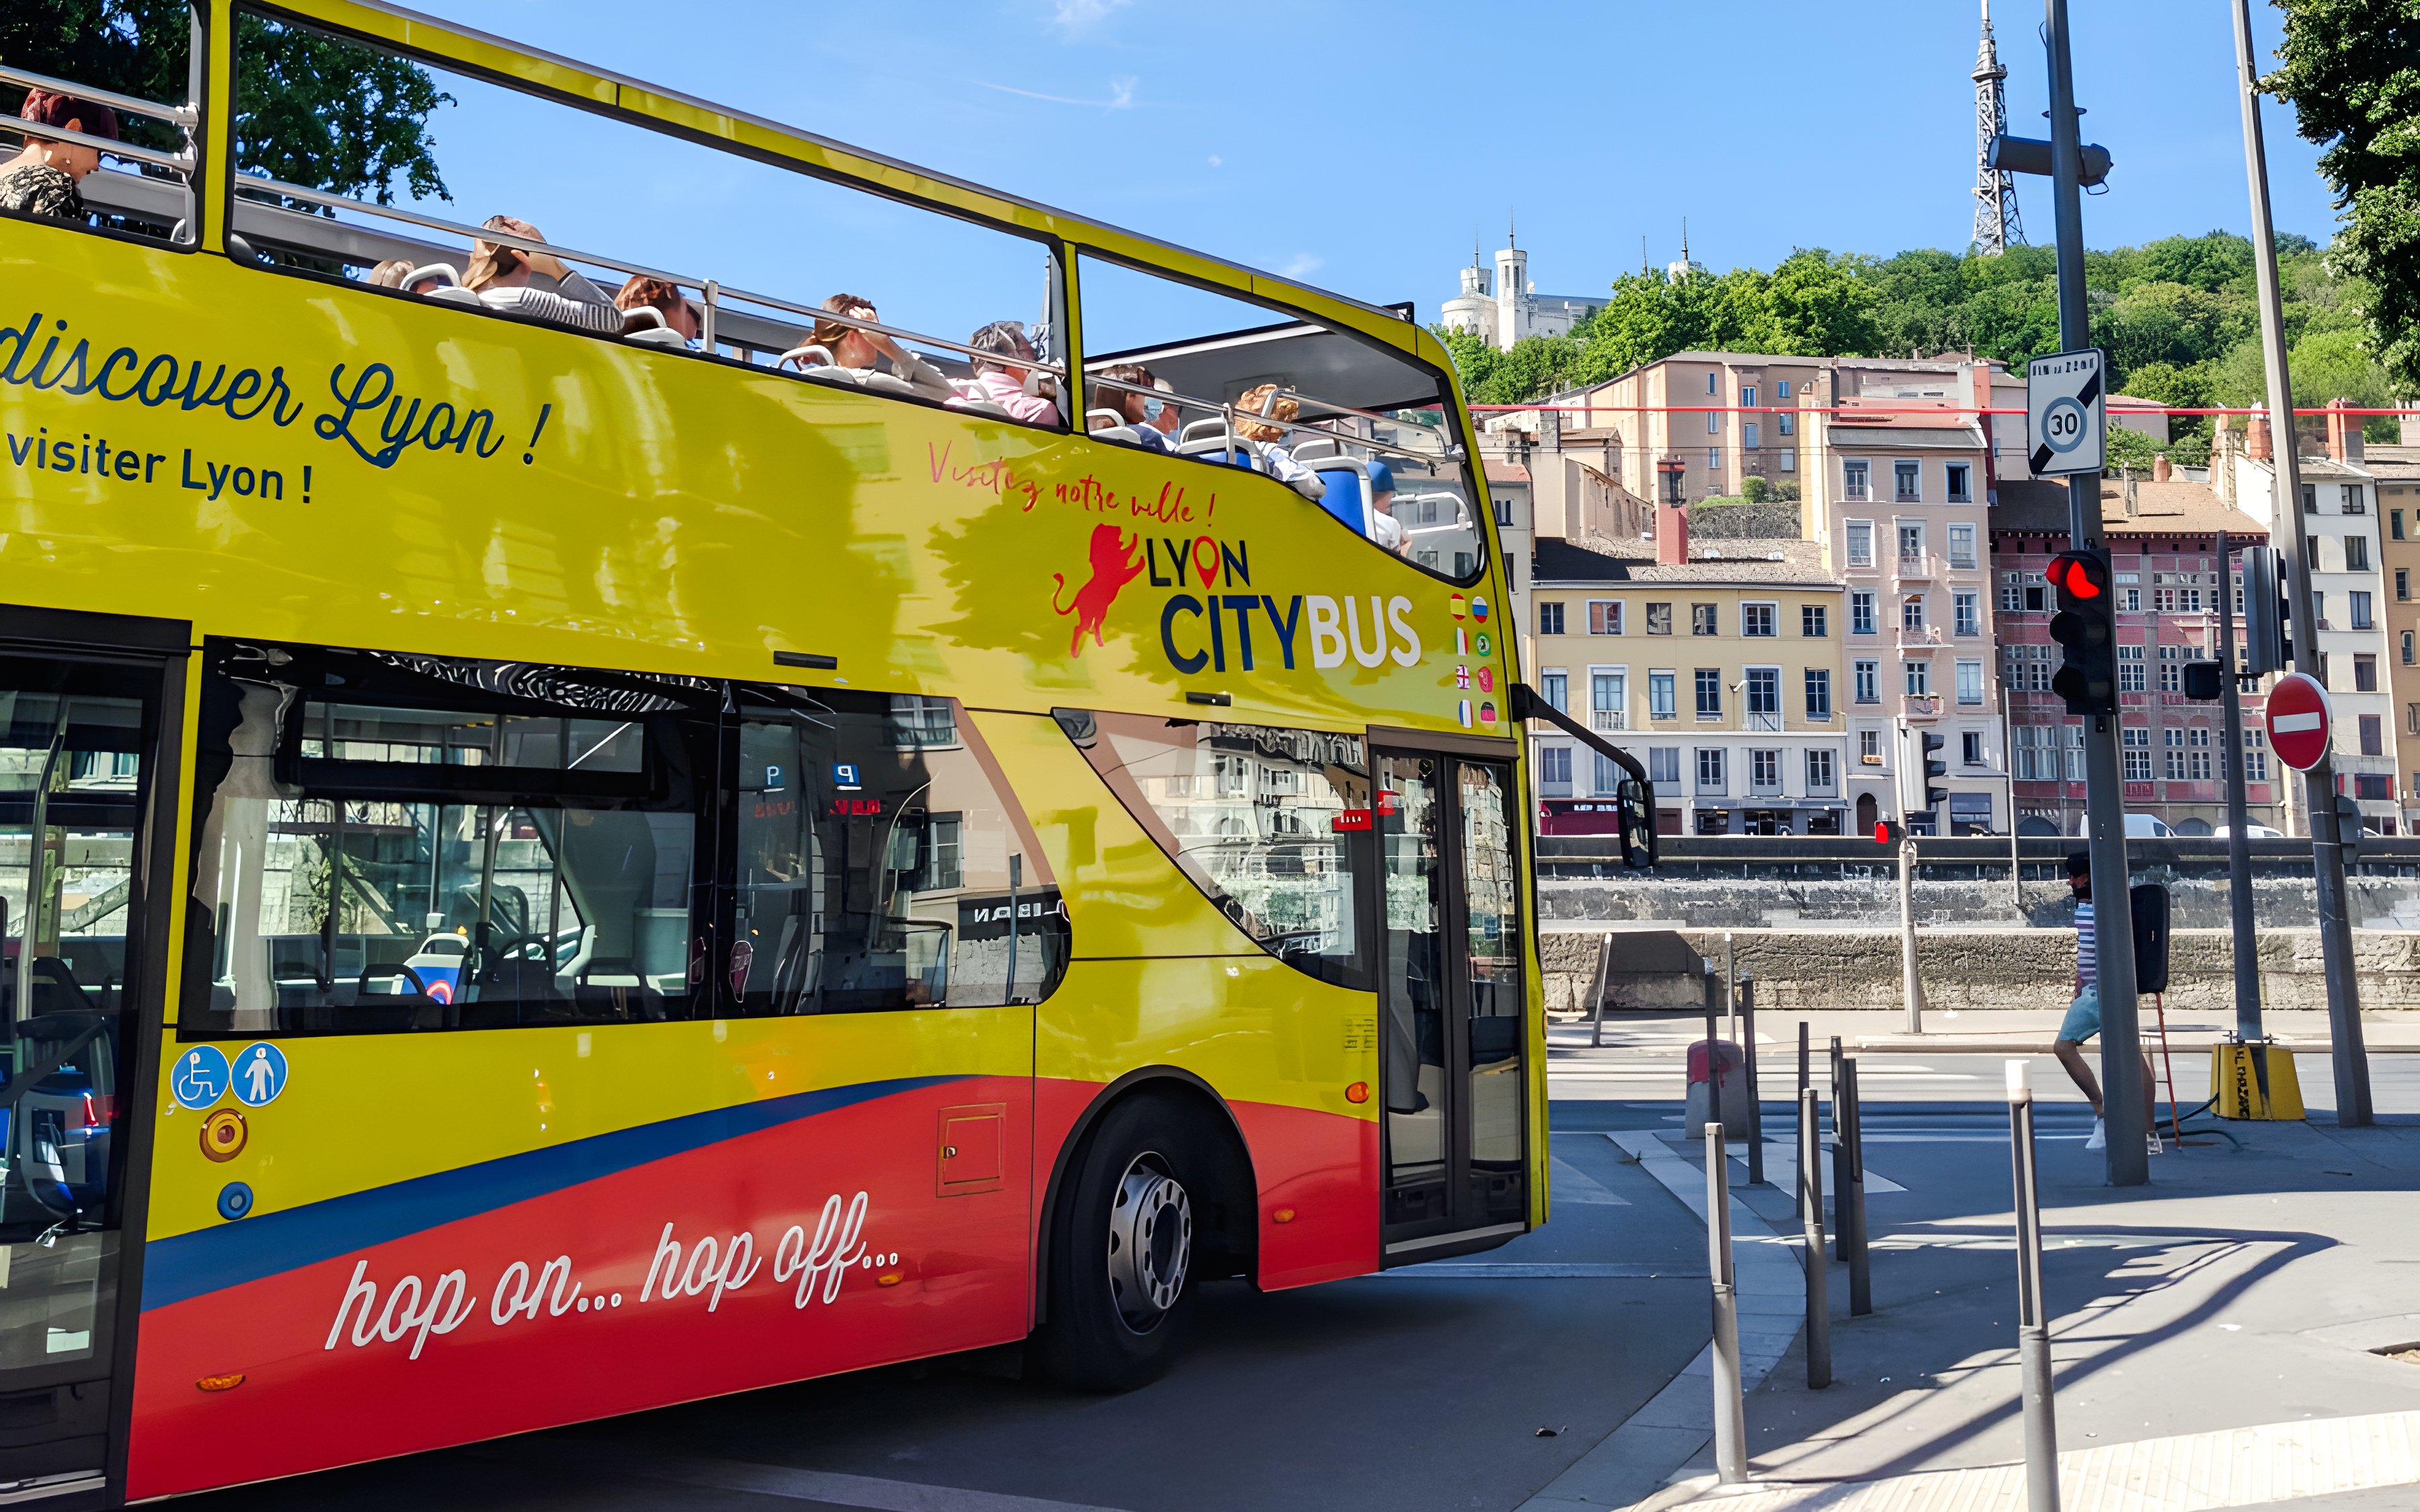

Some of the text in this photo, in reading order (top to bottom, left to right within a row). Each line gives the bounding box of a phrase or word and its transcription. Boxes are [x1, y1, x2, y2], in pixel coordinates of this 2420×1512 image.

[0, 312, 304, 427] discover
[314, 363, 505, 469] Lyon
[2050, 412, 2078, 436] 30
[7, 427, 166, 483] visiter
[182, 448, 283, 501] Lyon
[928, 439, 1045, 513] Visitez
[1056, 474, 1120, 512] notre
[1131, 480, 1195, 523] ville
[1145, 536, 1250, 590] LYON
[1160, 594, 1422, 675] CITYBUS
[324, 1191, 899, 1360] hop on... hop off...
